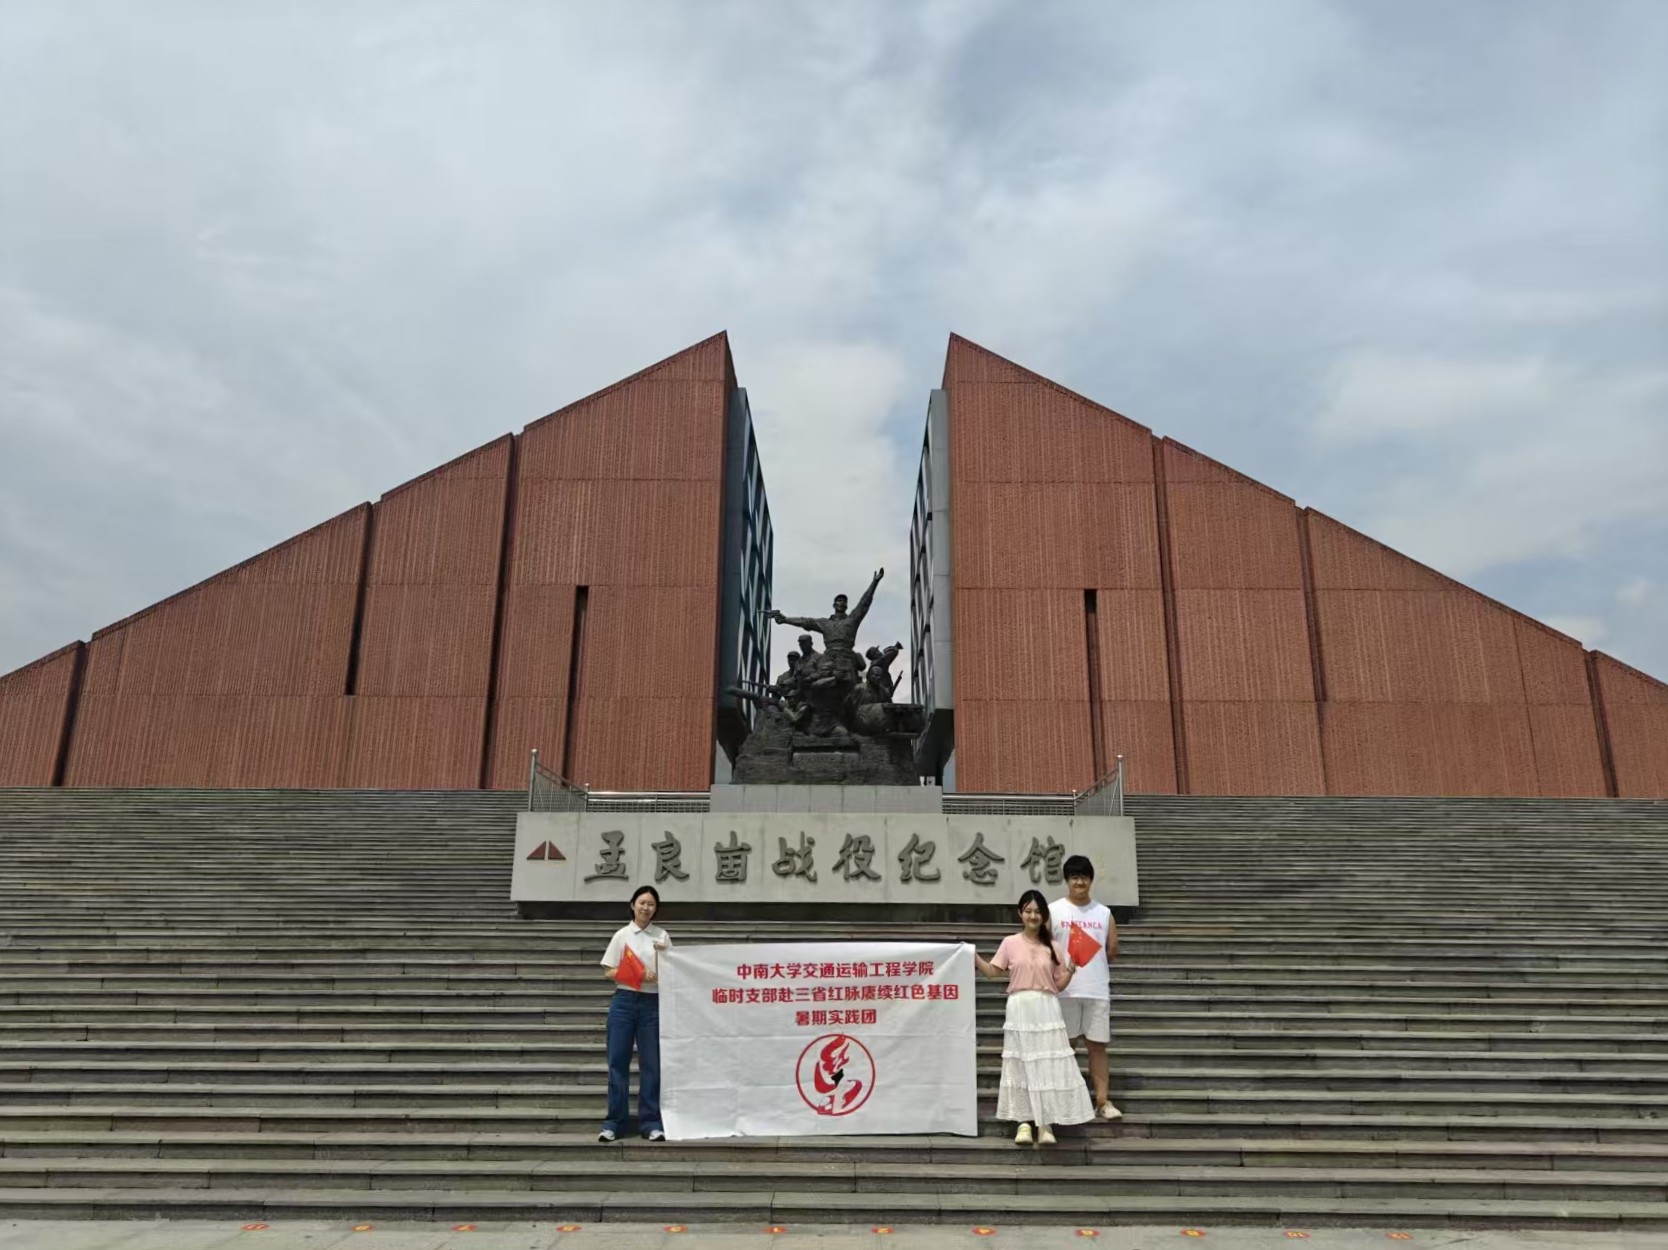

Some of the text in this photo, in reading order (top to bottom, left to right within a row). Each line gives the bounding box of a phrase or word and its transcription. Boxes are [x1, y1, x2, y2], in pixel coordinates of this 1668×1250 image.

[584, 831, 1065, 885] 孟良崮战役纪念馆
[737, 961, 934, 980] 中南大学交通运输工程学院
[795, 1009, 877, 1026] 暑期实践团
